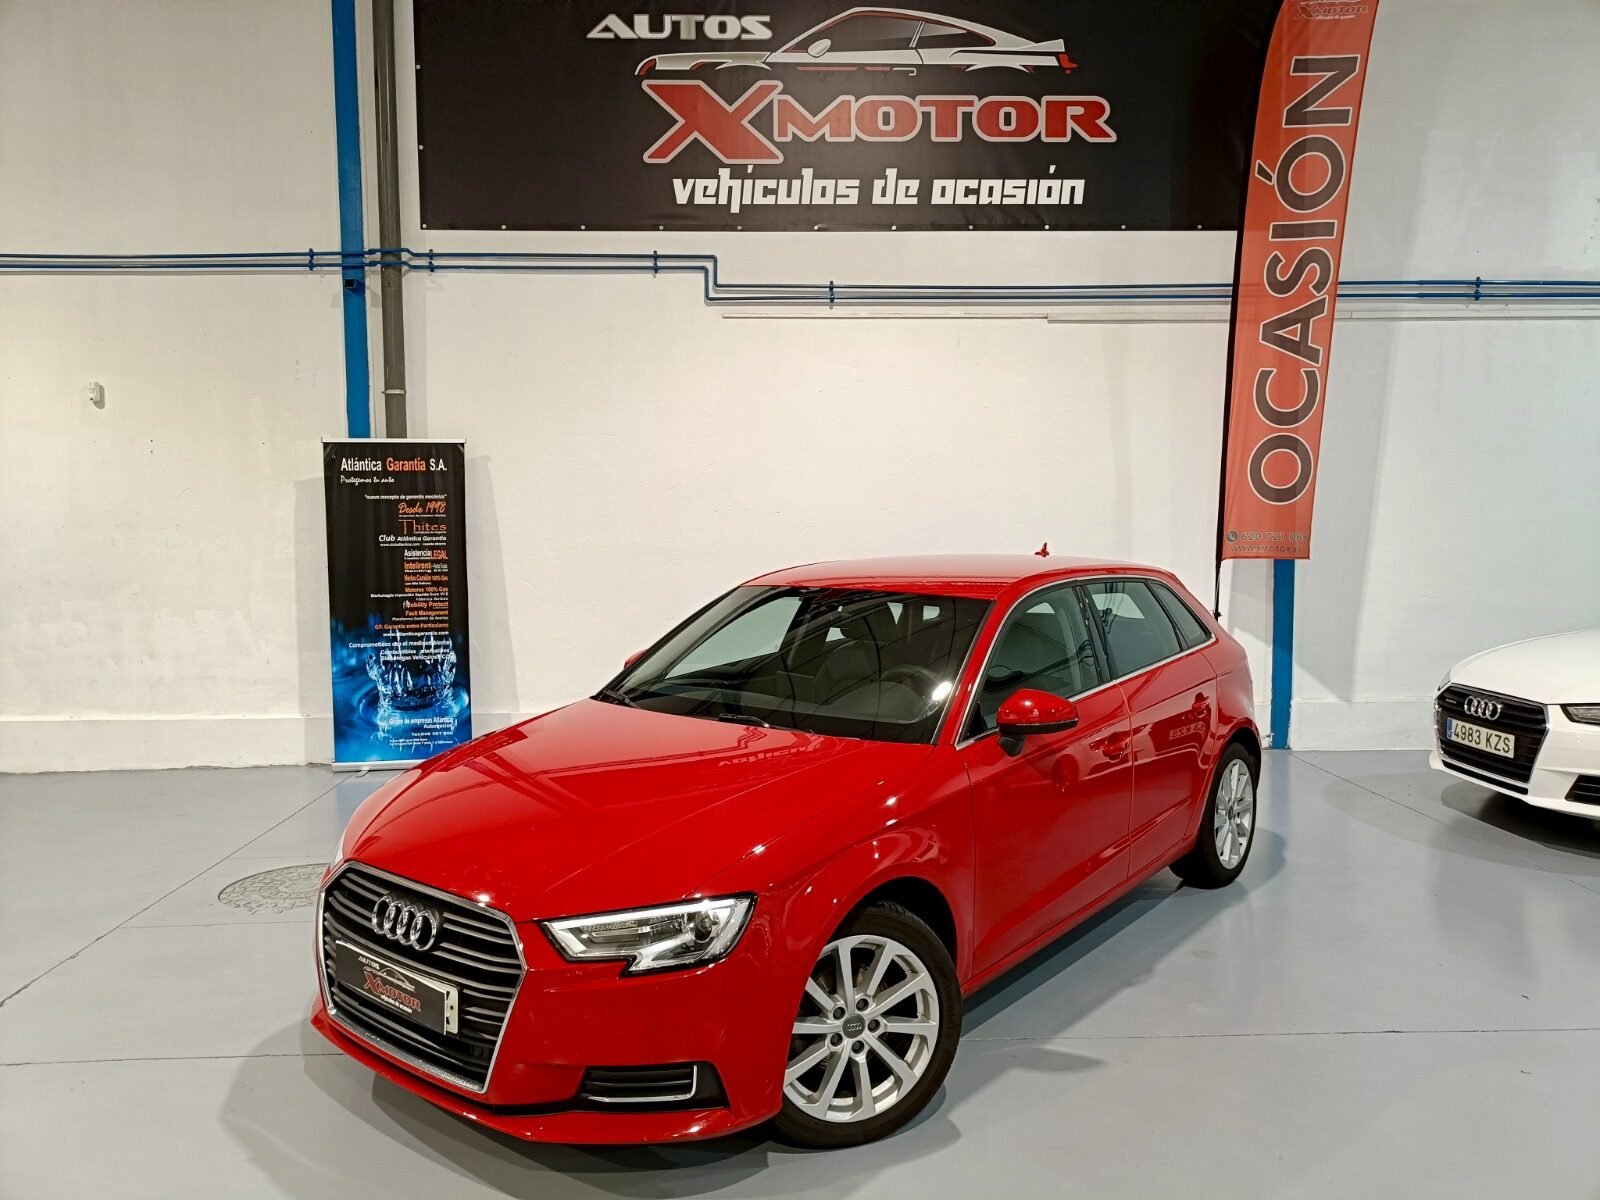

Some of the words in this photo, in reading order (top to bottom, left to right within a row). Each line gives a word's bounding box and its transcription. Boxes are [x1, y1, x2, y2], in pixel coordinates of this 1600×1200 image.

[586, 13, 774, 41] AUTOS
[642, 80, 1117, 164] XMOTOR
[672, 164, 860, 214] vehículos
[872, 167, 920, 205] de
[931, 164, 1085, 205] ocasión
[1247, 54, 1361, 506] OCASIÓN
[340, 457, 382, 471] Atlántica
[386, 456, 427, 471] Garantía
[429, 458, 448, 471] S.A.
[397, 501, 423, 514] Desde
[378, 534, 396, 542] Club
[1453, 722, 1482, 746] 4983
[1485, 731, 1511, 753] KZS
[358, 955, 380, 970] AUTOS
[363, 971, 421, 1012] XMOTOR
